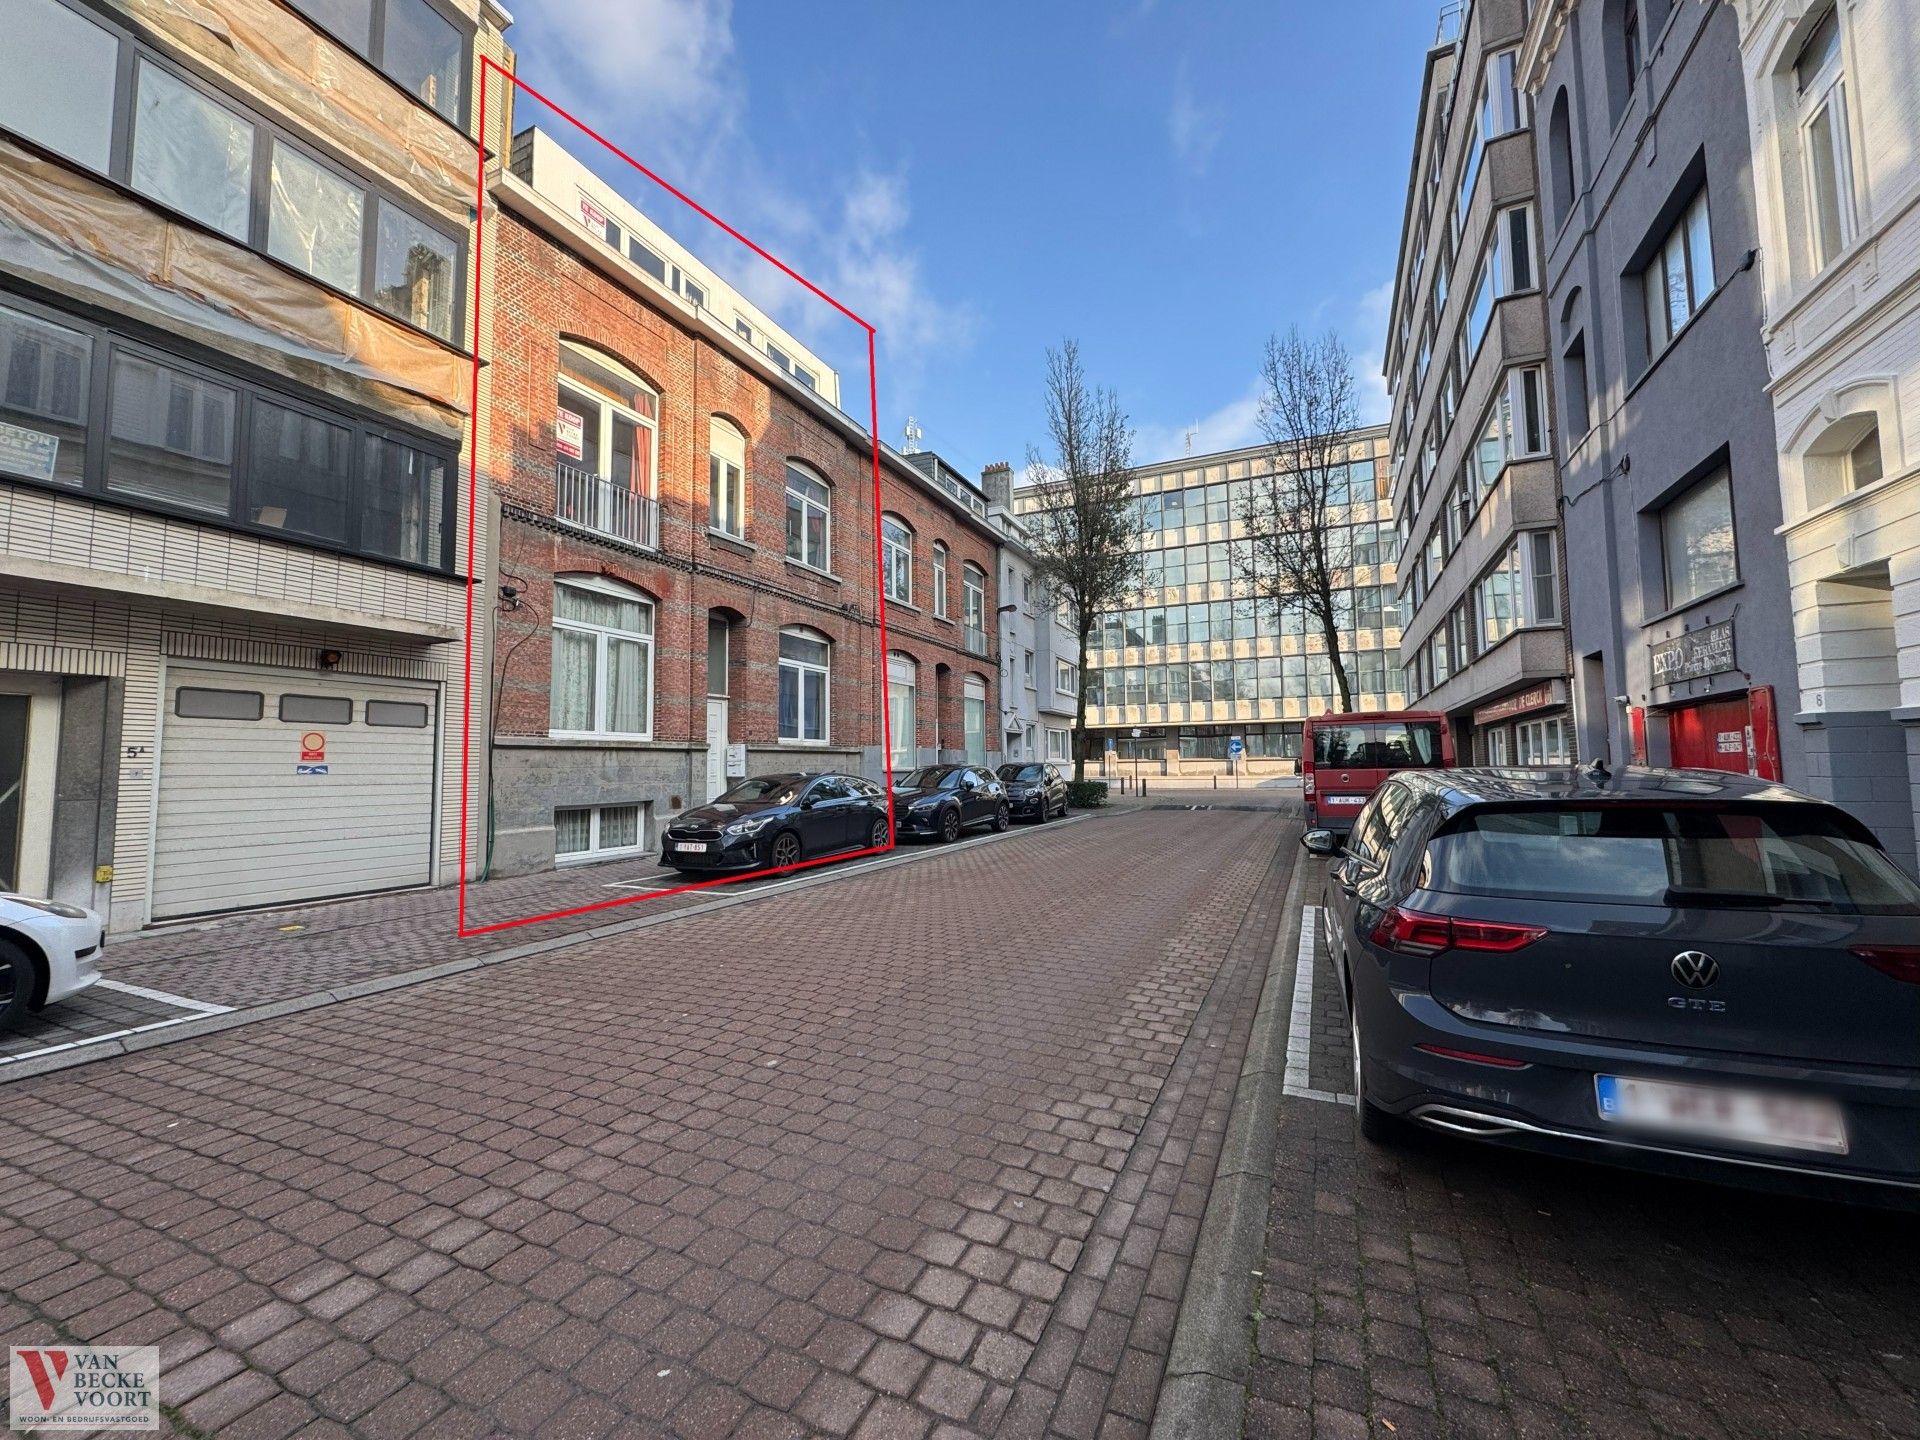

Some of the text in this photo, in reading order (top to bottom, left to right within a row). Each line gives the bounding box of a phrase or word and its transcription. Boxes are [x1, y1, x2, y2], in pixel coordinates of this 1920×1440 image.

[1653, 647, 1684, 675] EXPO
[1816, 694, 1823, 706] 6
[1668, 997, 1726, 1012] GTE
